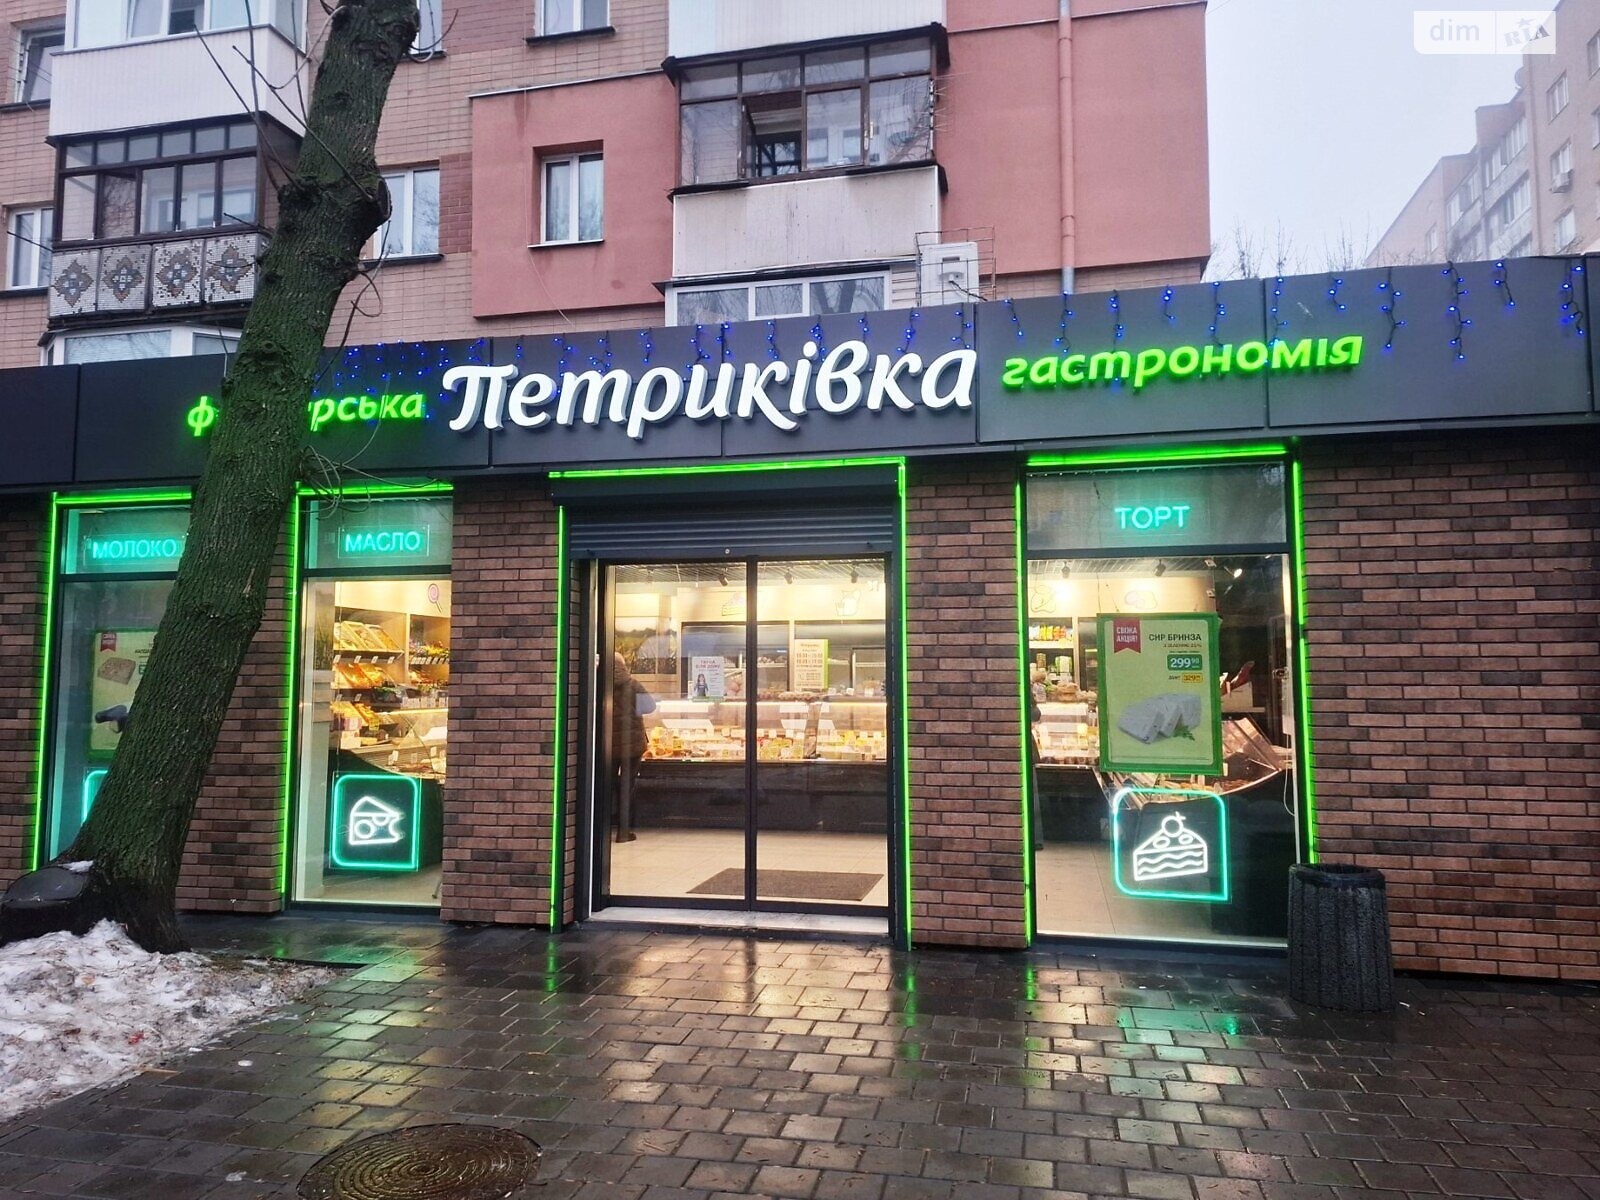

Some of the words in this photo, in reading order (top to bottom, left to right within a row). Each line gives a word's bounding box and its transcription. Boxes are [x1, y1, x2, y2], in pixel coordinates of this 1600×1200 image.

[441, 339, 978, 440] Петриківка
[1002, 335, 1364, 391] гастрономія
[1114, 505, 1190, 529] ТОРТ
[92, 538, 177, 559] МОЛОКО
[345, 531, 421, 553] МАСЛО
[1148, 633, 1166, 641] СИР
[1167, 633, 1202, 641] БРИНЗА
[1170, 657, 1191, 668] 299
